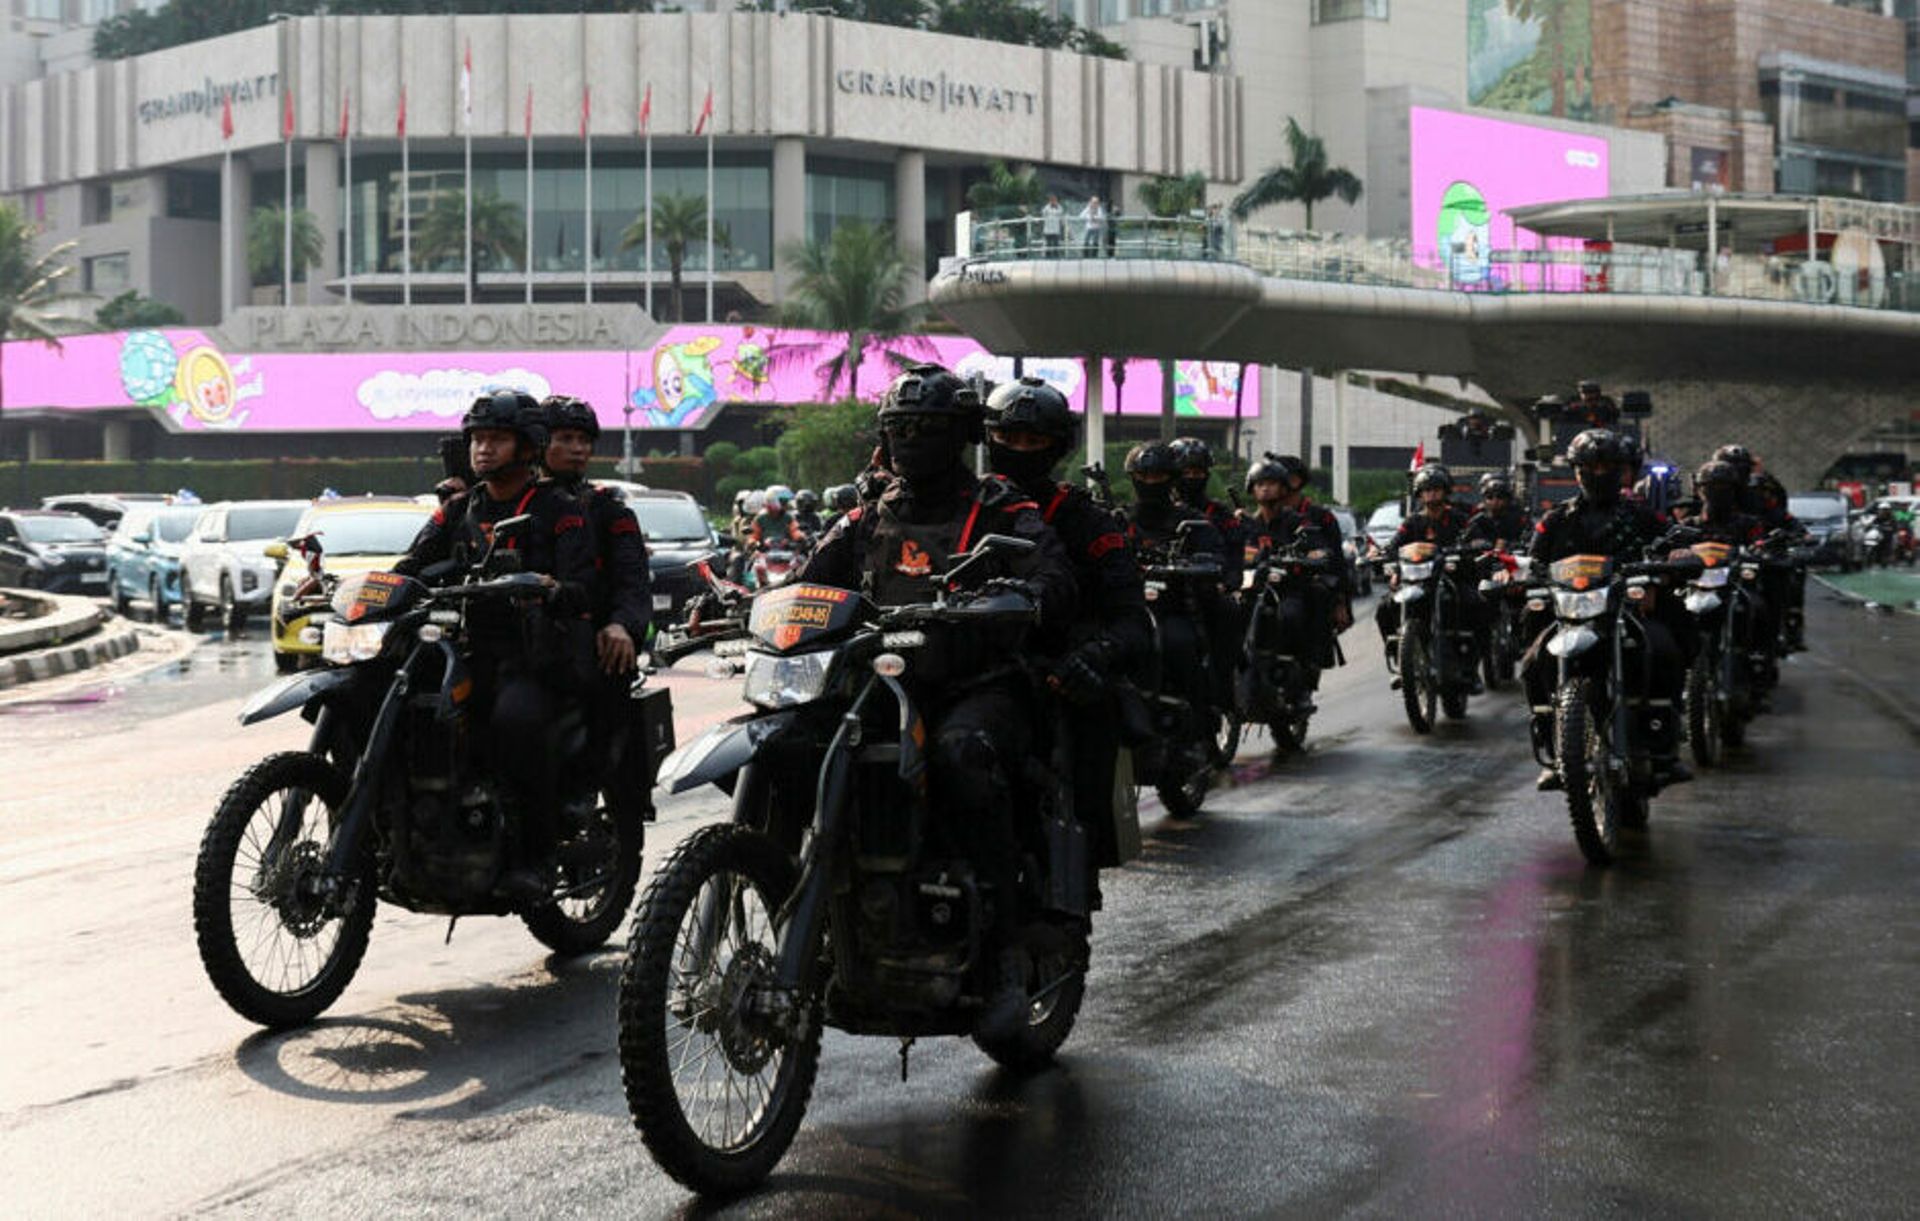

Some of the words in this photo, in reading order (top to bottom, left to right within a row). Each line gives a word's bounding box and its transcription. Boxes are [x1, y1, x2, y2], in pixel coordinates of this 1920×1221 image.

[139, 91, 205, 124] GRAND
[836, 69, 936, 103] GRAND
[948, 81, 1038, 115] HYATT
[249, 311, 383, 349] PLAZA
[397, 309, 620, 347] INDONESIA
